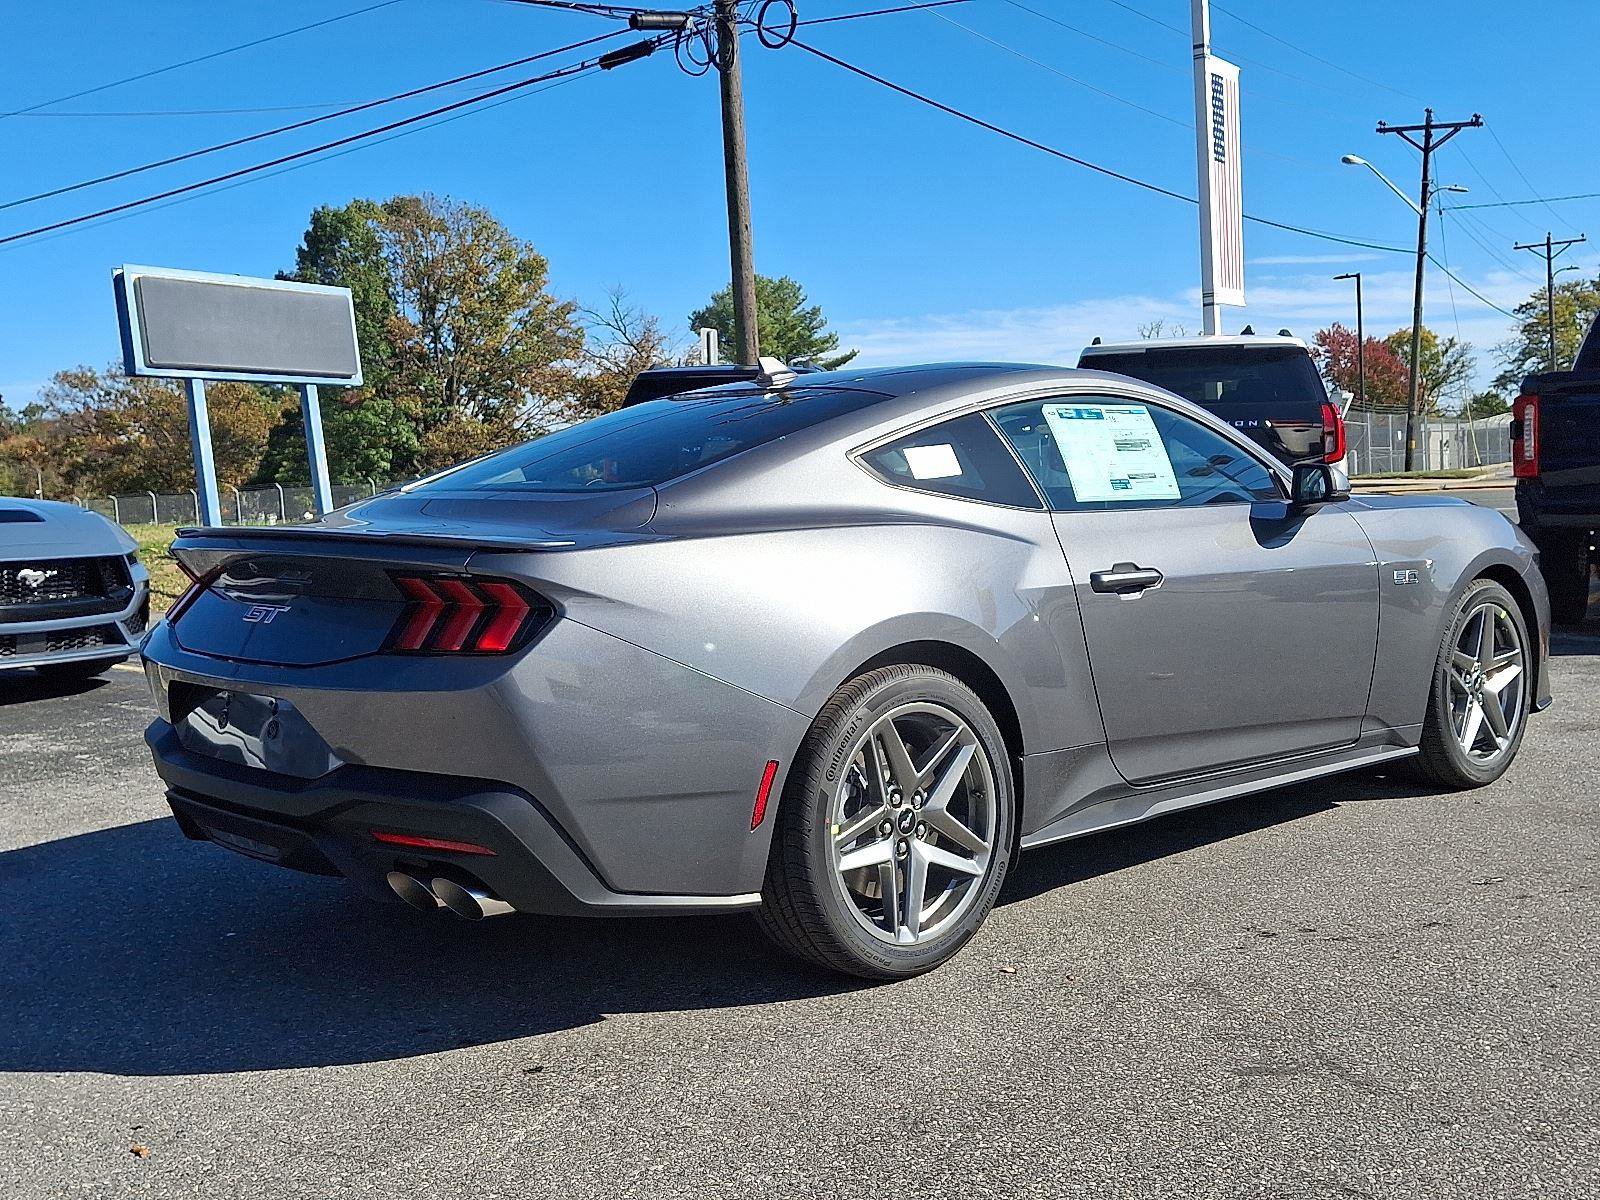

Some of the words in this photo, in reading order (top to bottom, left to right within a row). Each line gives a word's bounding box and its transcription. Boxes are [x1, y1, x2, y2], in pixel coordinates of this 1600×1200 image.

[242, 603, 292, 624] GT
[825, 721, 859, 782] Continental
[980, 861, 1006, 918] Continental
